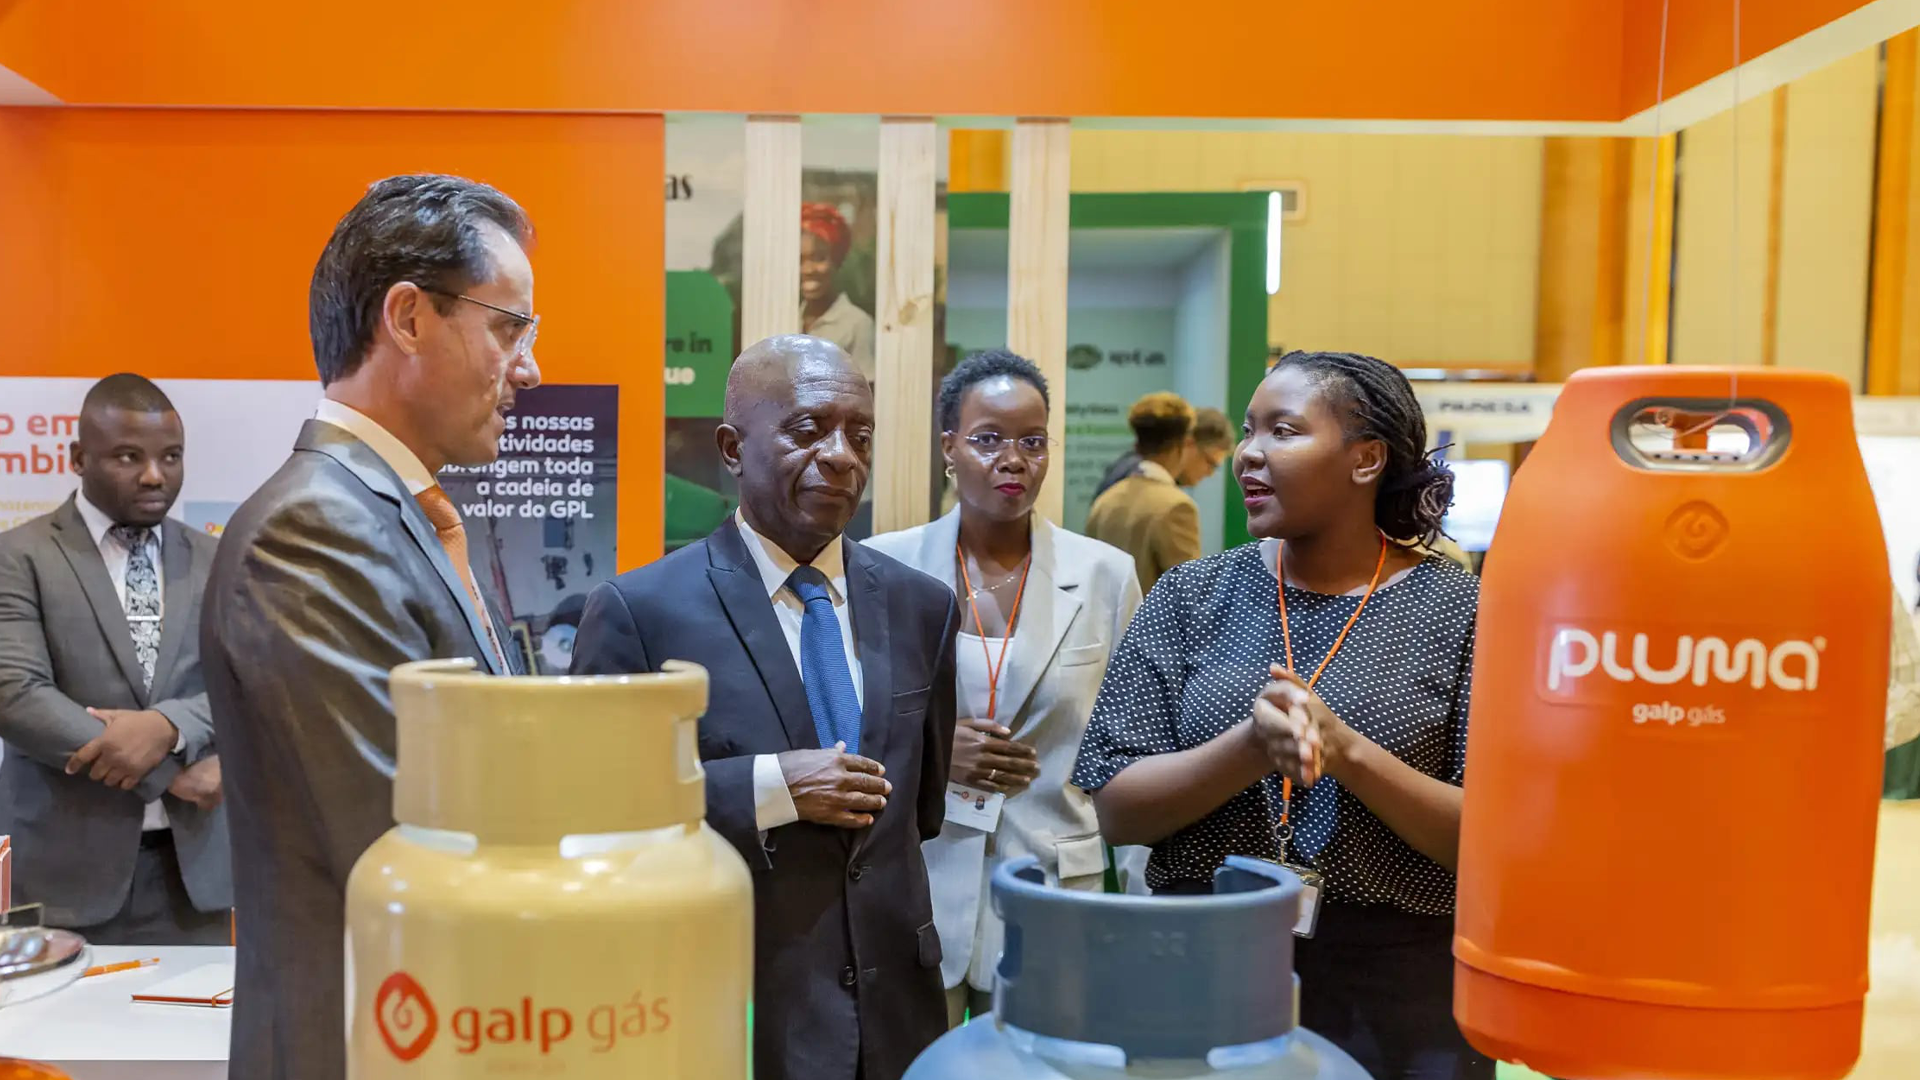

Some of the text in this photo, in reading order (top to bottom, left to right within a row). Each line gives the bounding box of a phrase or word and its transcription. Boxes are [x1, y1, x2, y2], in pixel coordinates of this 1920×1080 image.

[690, 331, 712, 354] in
[27, 413, 80, 436] em
[505, 415, 595, 431] s nossas
[498, 433, 595, 453] tividades
[0, 443, 75, 474] mbi
[544, 456, 594, 475] toda
[476, 478, 595, 496] a cadeia de
[462, 499, 594, 518] valor do GPL
[1632, 700, 1726, 726] galp gás
[451, 990, 672, 1054] galp gás
